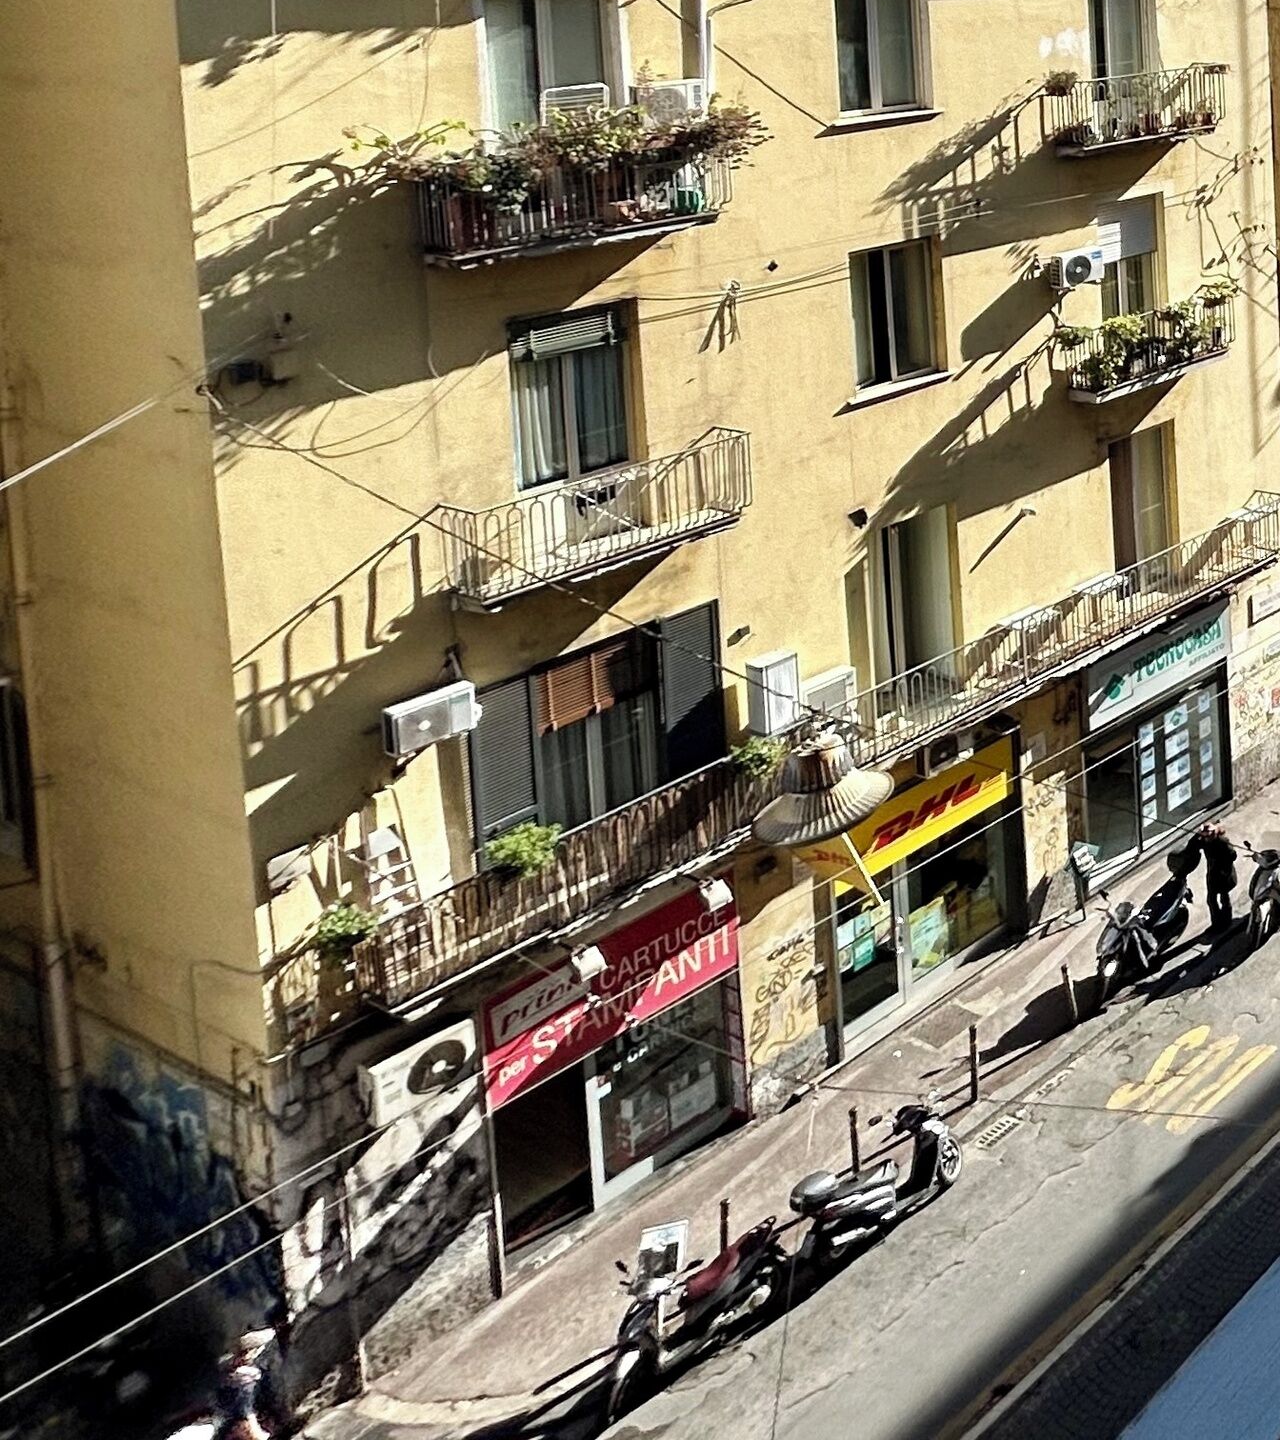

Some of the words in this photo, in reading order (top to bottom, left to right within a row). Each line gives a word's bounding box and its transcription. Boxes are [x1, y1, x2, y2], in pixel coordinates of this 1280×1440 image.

[1133, 617, 1222, 682] TECNOCASA
[1188, 642, 1226, 667] AFFILIATO
[873, 773, 982, 852] DHL
[600, 910, 727, 990] CARTUCCE
[498, 1054, 529, 1086] per
[532, 924, 730, 1064] STAMPANTI
[501, 972, 581, 1036] prin
